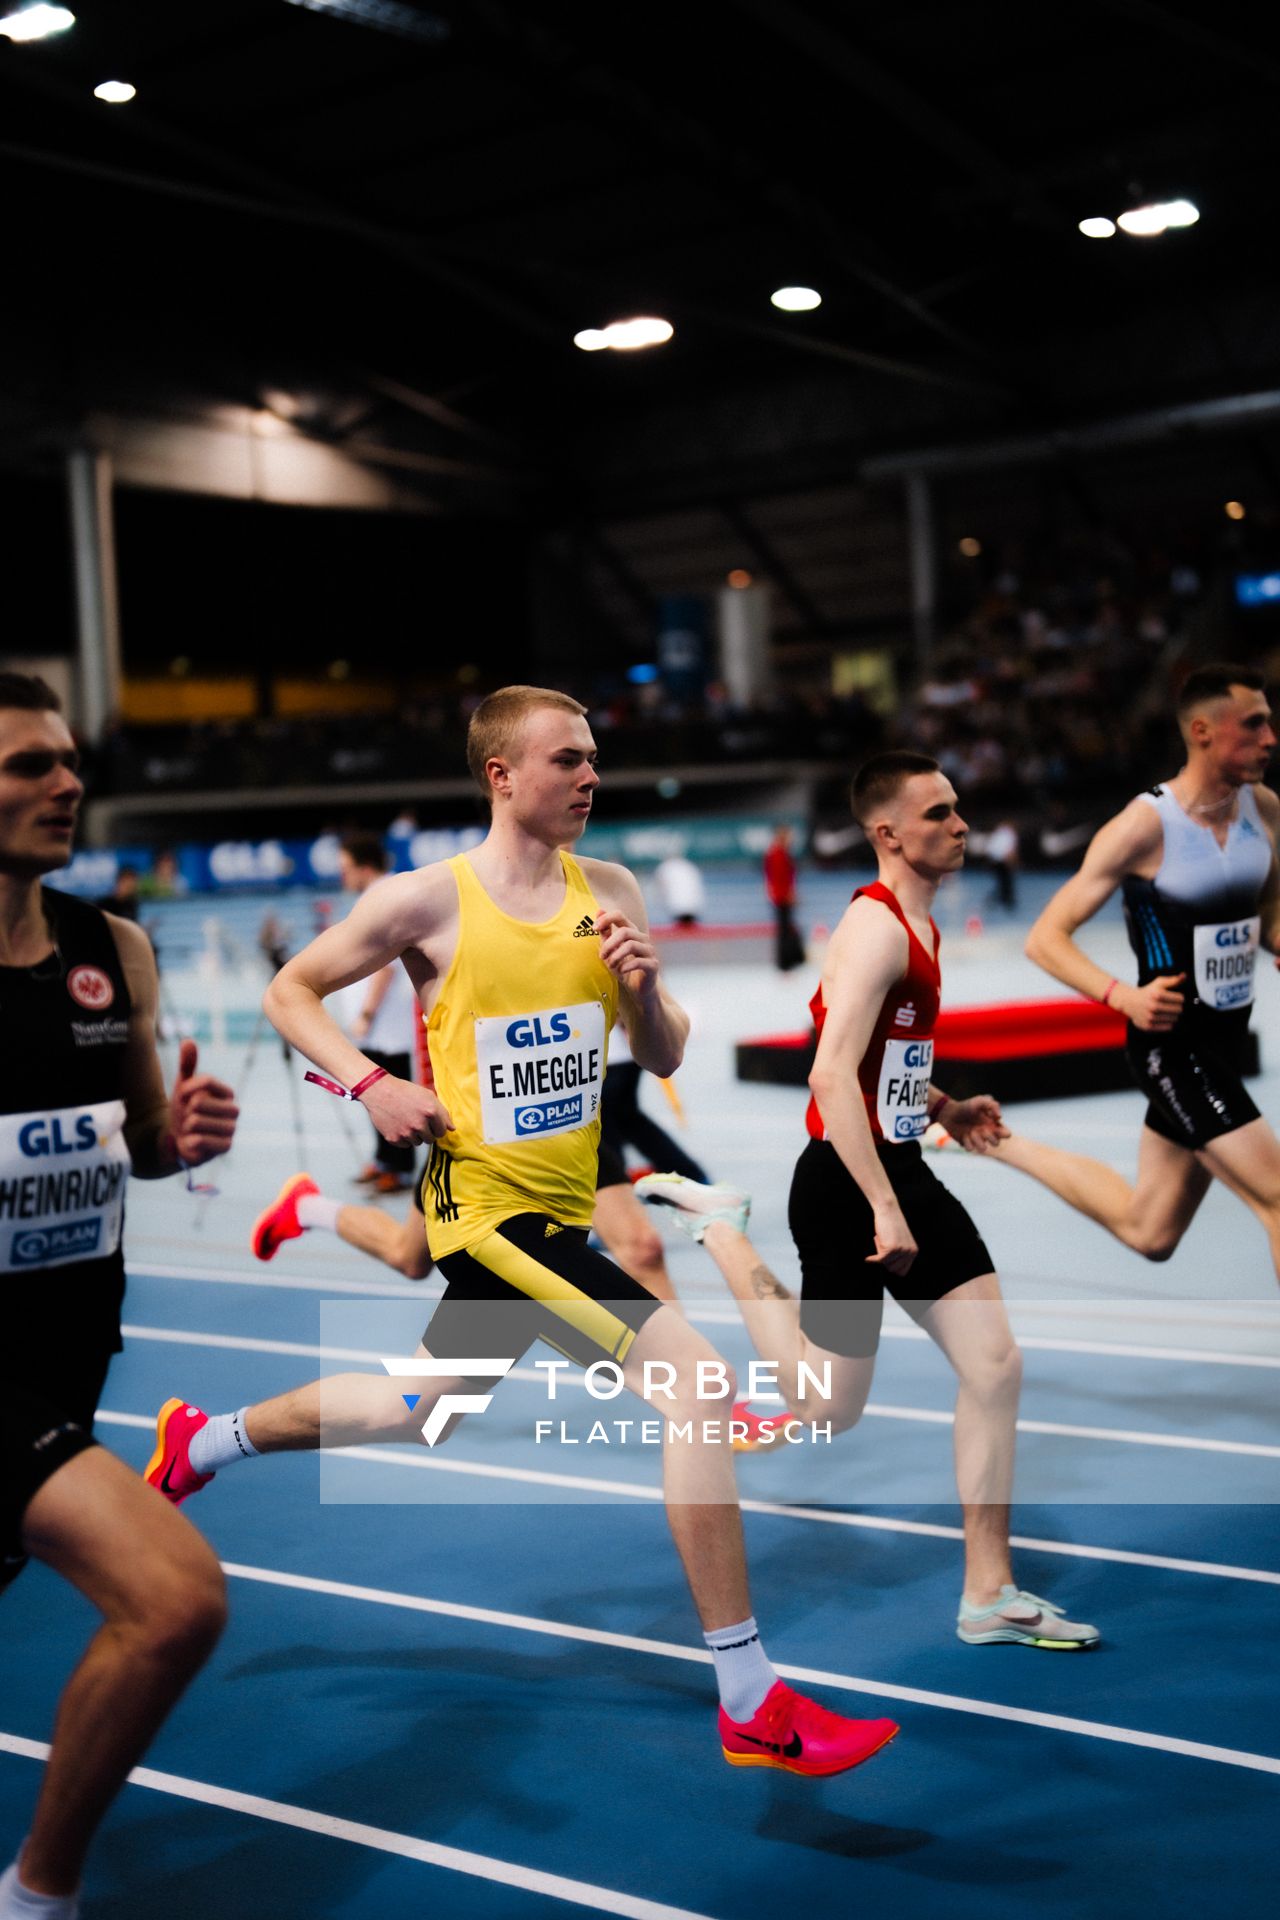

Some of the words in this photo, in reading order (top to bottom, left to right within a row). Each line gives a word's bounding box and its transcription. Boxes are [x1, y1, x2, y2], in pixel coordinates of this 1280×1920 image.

[572, 927, 600, 938] adida
[489, 1048, 599, 1099] E.MEGGLE
[546, 1100, 580, 1120] PLAN
